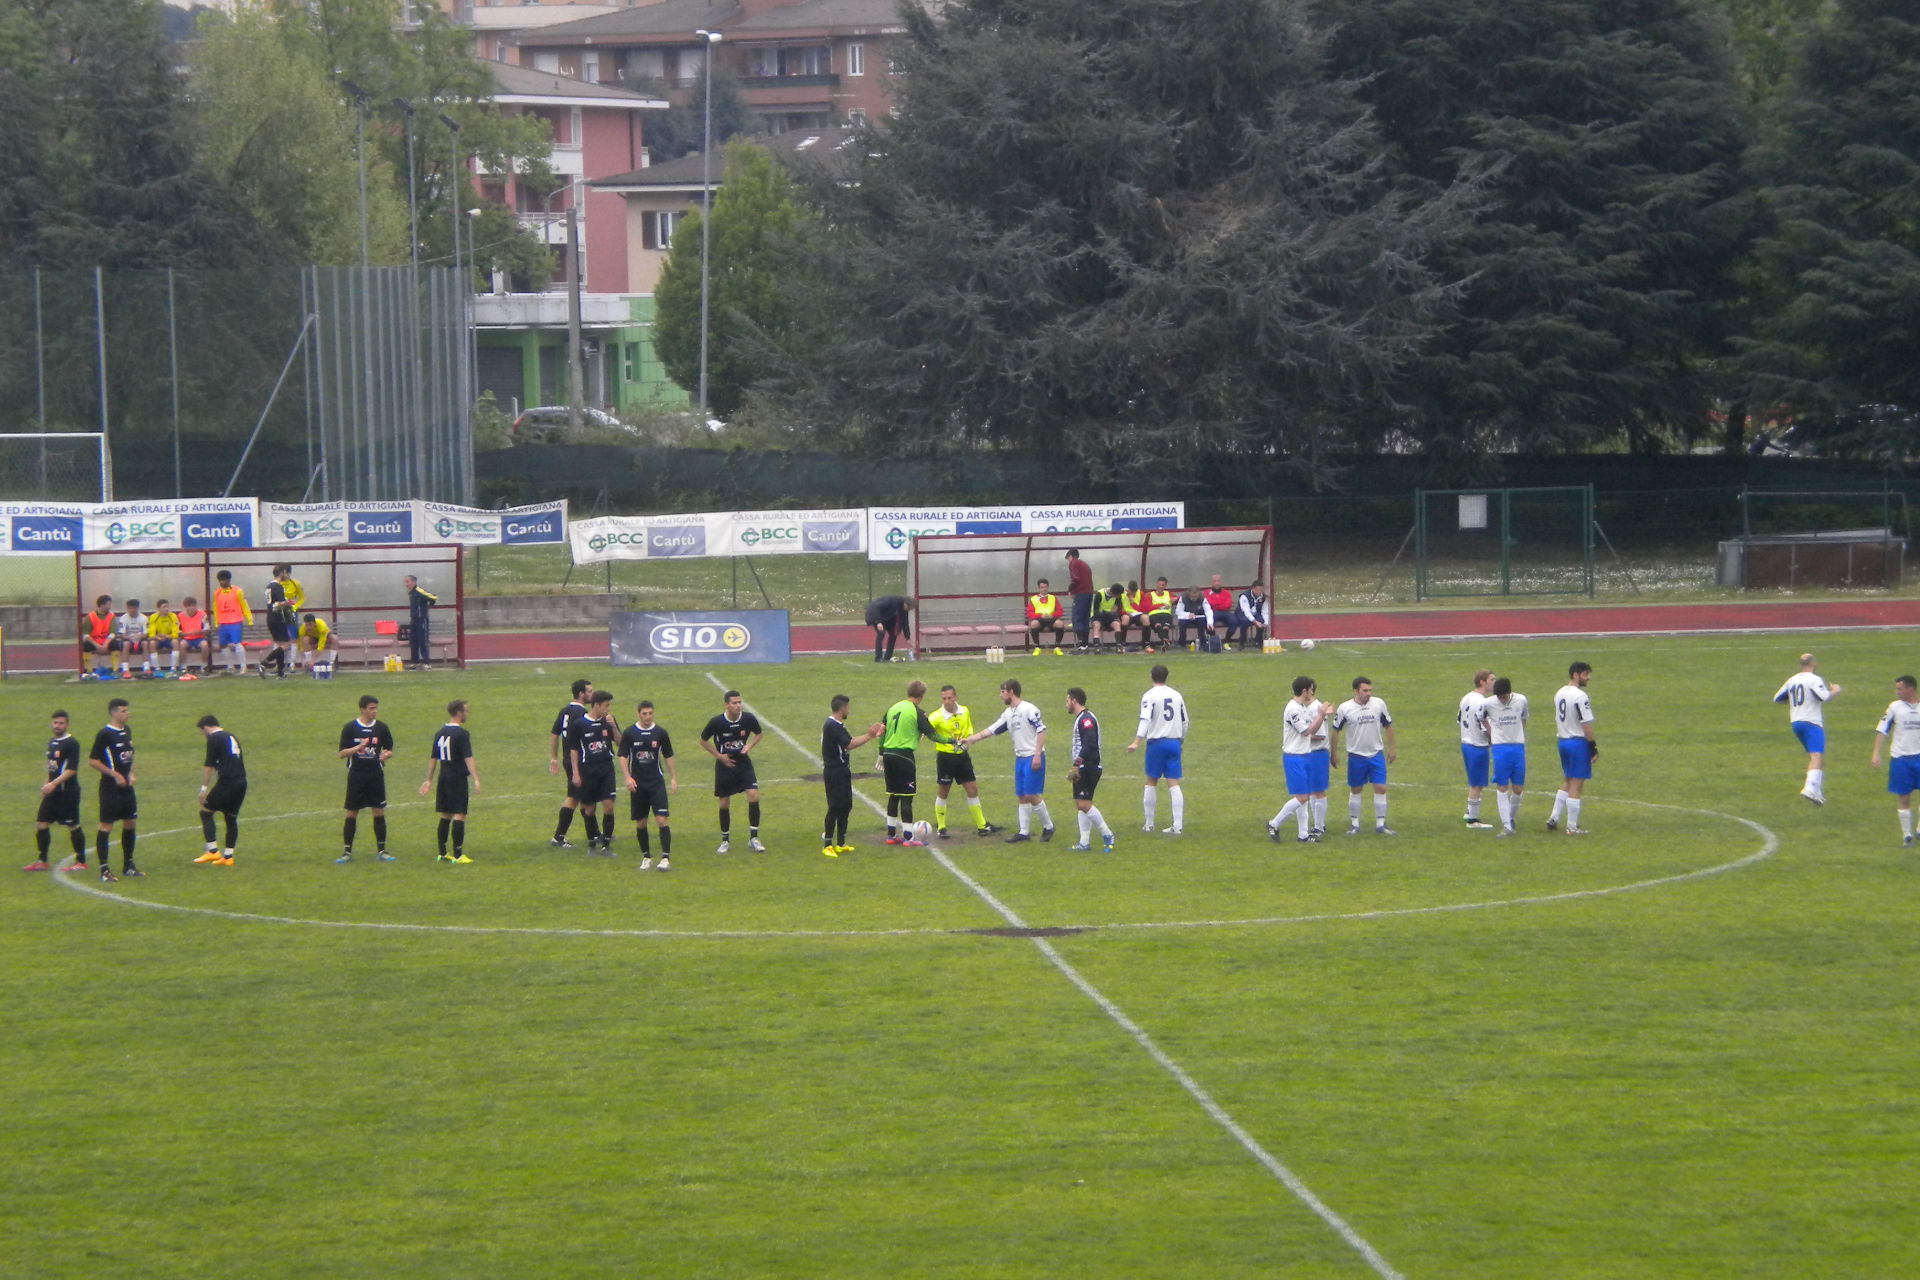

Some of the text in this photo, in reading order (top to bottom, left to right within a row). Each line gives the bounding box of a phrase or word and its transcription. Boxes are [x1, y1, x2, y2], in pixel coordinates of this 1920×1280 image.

[6, 506, 21, 515] ED
[24, 506, 84, 516] ARTIGIANA
[93, 502, 252, 515] CASSA RURALE ED ARTIGIANA
[272, 501, 412, 513] CASSA RURALE ED ARTIGIANA
[424, 503, 456, 512] CASSA
[508, 502, 563, 514] ARTIGIANA
[1030, 507, 1178, 519] CASSA RURALE ED ARTIGIANA
[731, 511, 860, 522] CASSA RURALE ED ARTIGIANA
[874, 511, 1022, 520] CASSA RURALE ED ARTIGIANA
[129, 521, 175, 536] BCC
[187, 521, 240, 538] Cantù
[303, 518, 344, 532] BCC
[354, 522, 401, 535] Cantù
[455, 519, 497, 532] BCC
[506, 521, 552, 536] Cantù
[18, 527, 72, 541] Cantù
[606, 532, 643, 545] BCC
[652, 533, 696, 547] Cantù
[761, 527, 798, 540] BCC
[807, 530, 850, 542] Cantù
[660, 627, 717, 648] SIO
[1790, 683, 1805, 707] 10
[1163, 697, 1175, 722] 5
[1558, 698, 1567, 722] 9
[892, 712, 902, 734] 1
[229, 735, 241, 758] 4
[436, 735, 452, 761] 11
